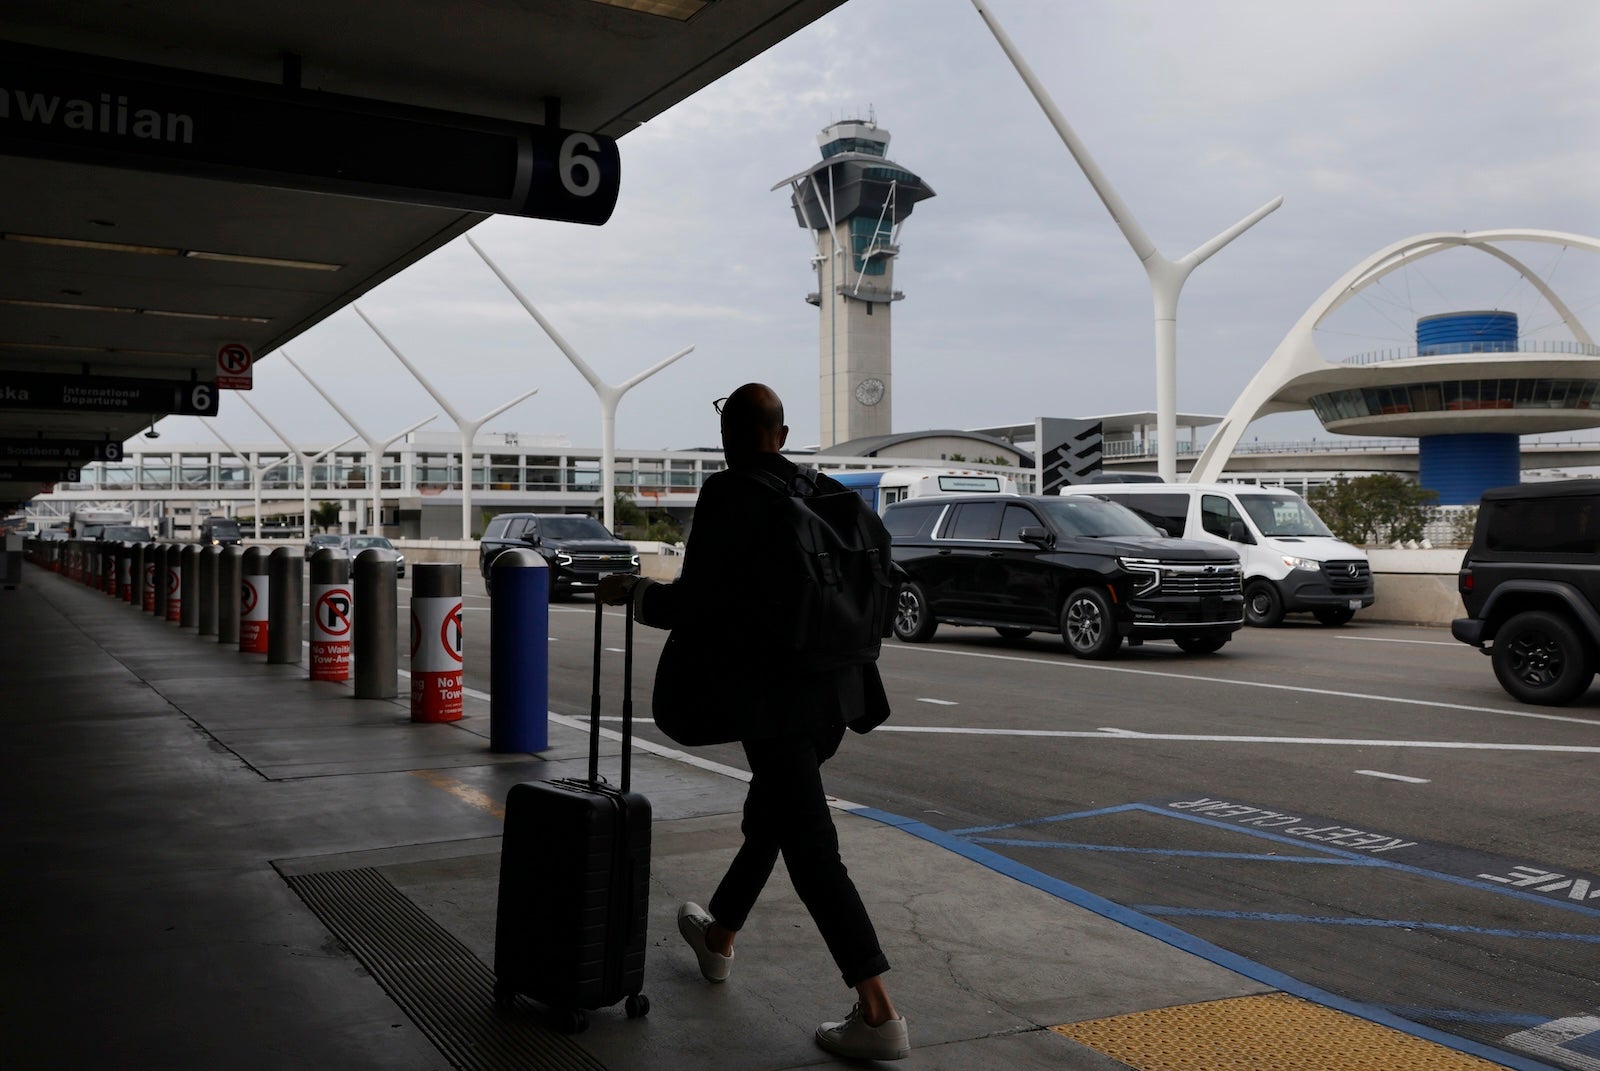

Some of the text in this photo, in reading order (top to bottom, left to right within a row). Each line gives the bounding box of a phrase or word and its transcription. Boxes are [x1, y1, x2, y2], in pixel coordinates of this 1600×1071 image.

[558, 132, 602, 197] 6
[63, 385, 140, 399] International
[192, 385, 211, 411] 6
[63, 394, 128, 407] Departures
[105, 442, 119, 459] 6
[67, 468, 77, 481] 6
[437, 676, 453, 688] No
[1167, 797, 1418, 853] KEEP CLEAR
